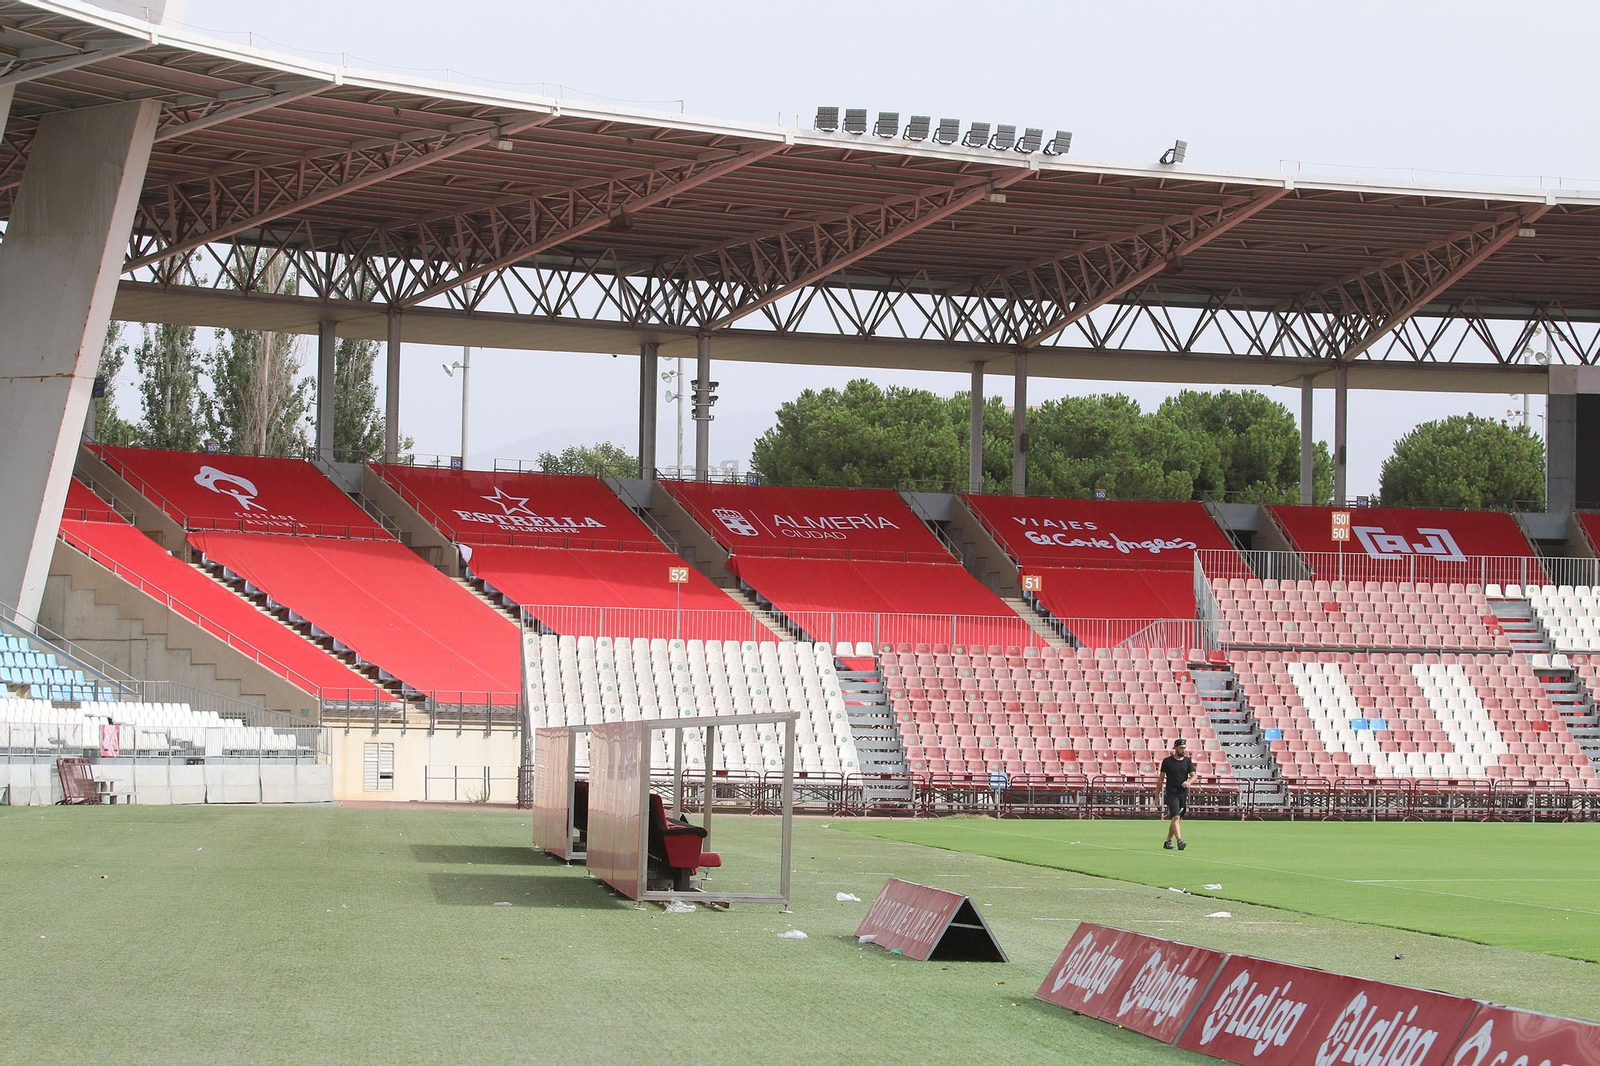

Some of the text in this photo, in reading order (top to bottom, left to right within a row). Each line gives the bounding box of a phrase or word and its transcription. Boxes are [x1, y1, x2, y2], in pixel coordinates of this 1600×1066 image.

[452, 509, 607, 528] ESTRELLA
[774, 513, 900, 530] ALMERÍA
[1012, 516, 1098, 531] VIAJES
[1332, 514, 1346, 525] 150
[498, 524, 580, 534] DE LEVANTE
[781, 529, 847, 540] CIUDAD
[1333, 528, 1345, 539] 50
[1024, 530, 1197, 554] El Corte Inglés
[670, 569, 687, 581] 52
[1024, 577, 1040, 589] 51
[1069, 941, 1124, 1003] LaLiga
[1136, 959, 1198, 1026] LaLiga
[1224, 981, 1307, 1056] LaLiga
[1341, 1005, 1439, 1066] LaLiga
